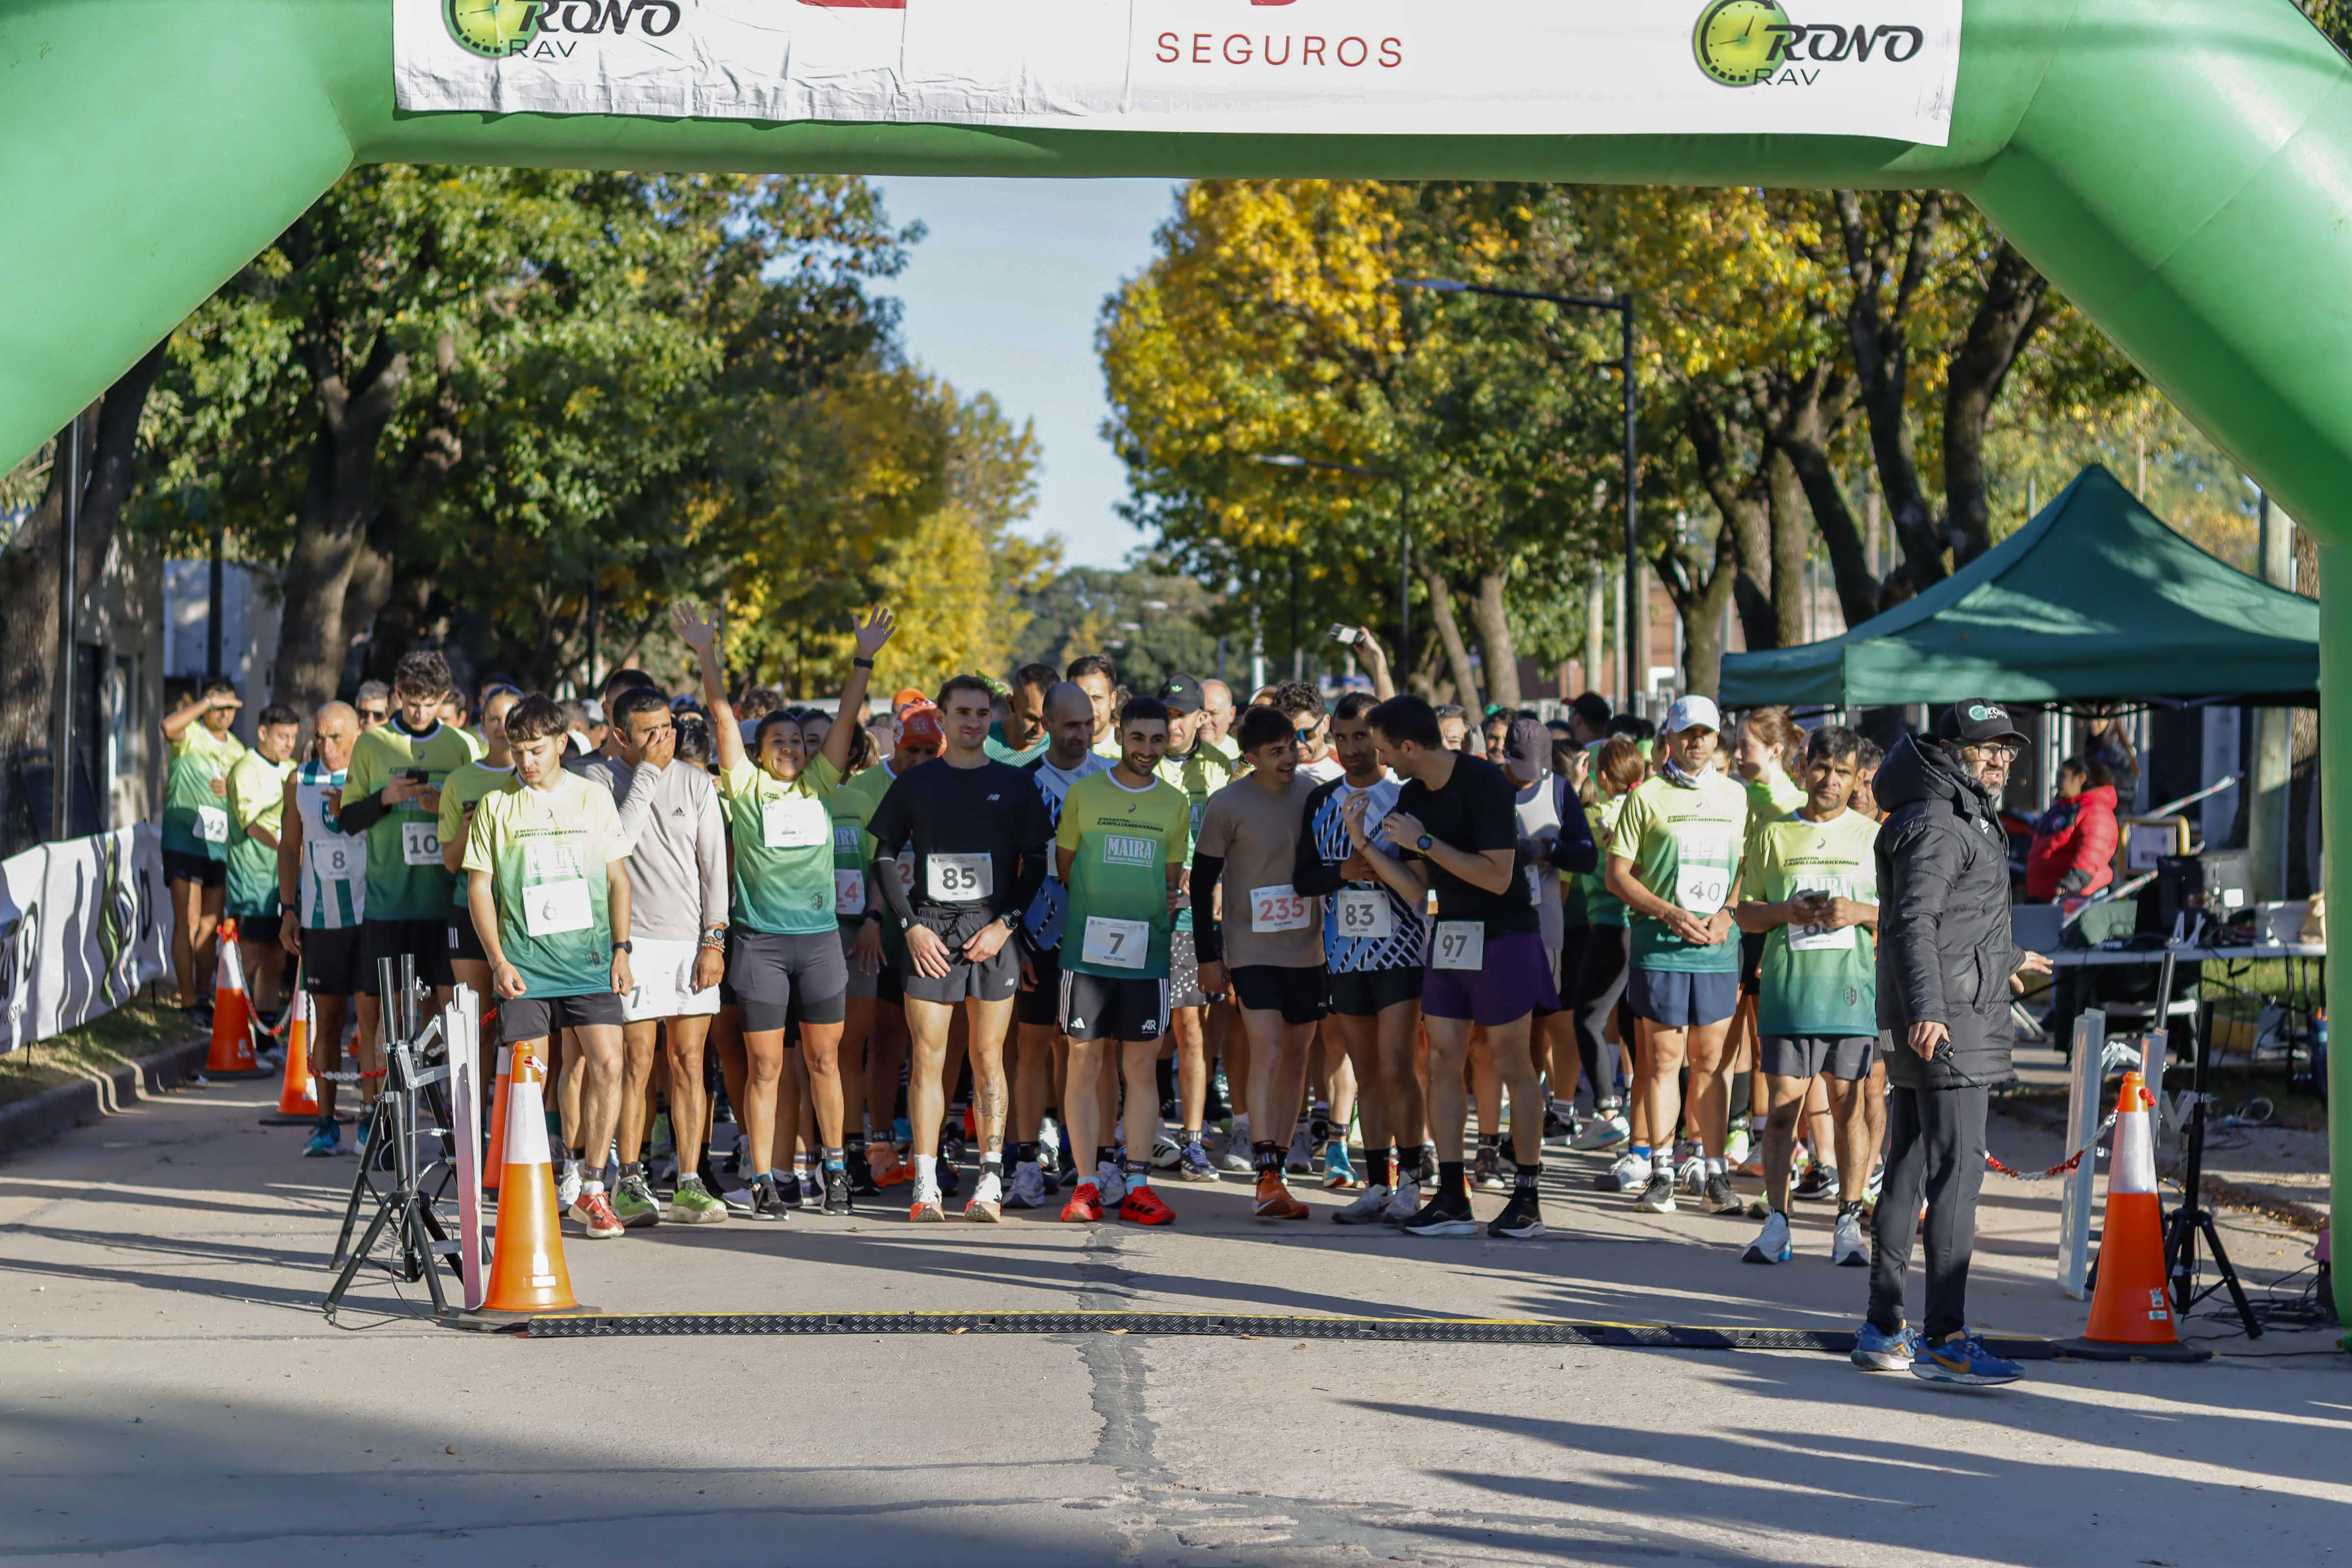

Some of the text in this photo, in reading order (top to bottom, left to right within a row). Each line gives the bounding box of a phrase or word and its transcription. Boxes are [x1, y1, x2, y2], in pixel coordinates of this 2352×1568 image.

[509, 40, 578, 58] RAV
[1156, 32, 1402, 68] SEGUROS
[1753, 68, 1821, 86] RAV
[409, 834, 440, 854] 10
[834, 829, 858, 845] IRA
[1107, 837, 1152, 859] MAIRA
[332, 850, 345, 869] 8
[942, 867, 977, 890] 85
[835, 881, 859, 902] 14
[1689, 881, 1720, 902] 40
[1259, 896, 1305, 921] 235
[1346, 904, 1375, 926] 83
[1109, 932, 1125, 955] 7
[1443, 934, 1468, 957] 97
